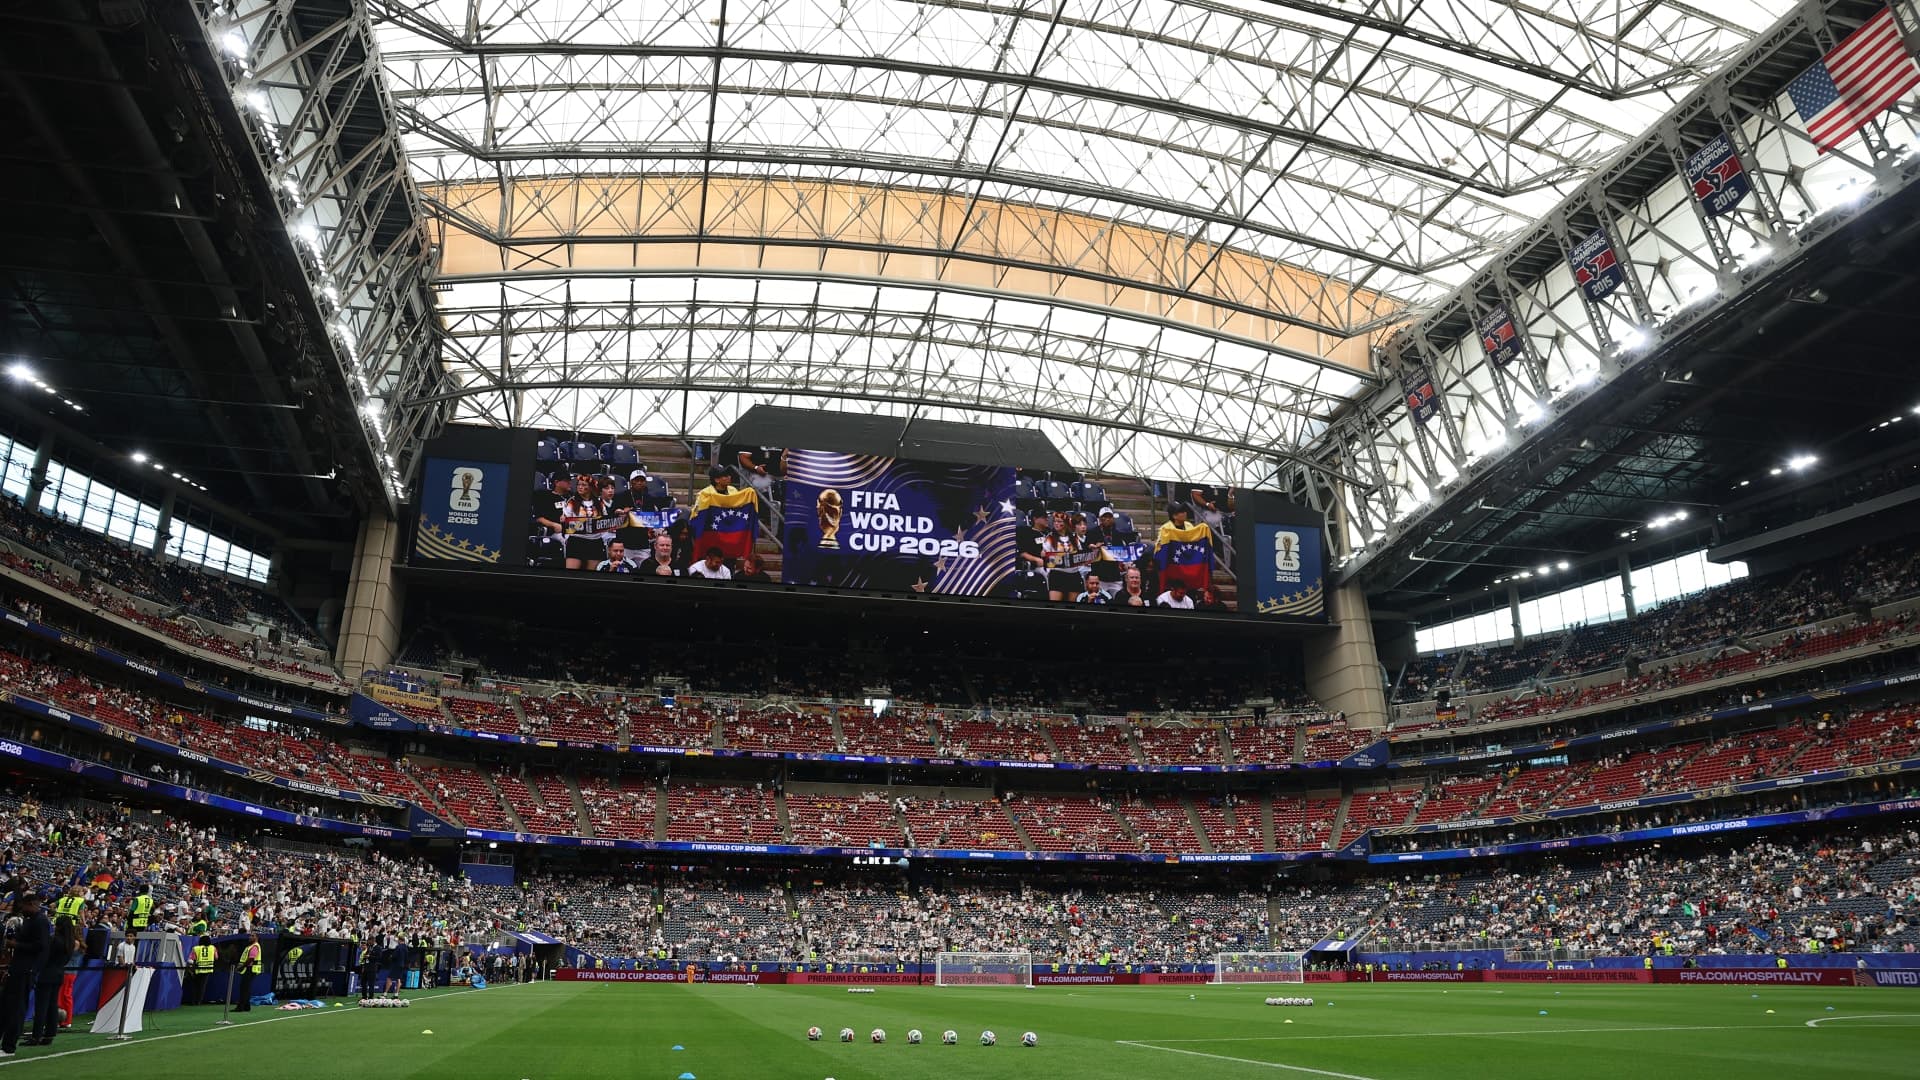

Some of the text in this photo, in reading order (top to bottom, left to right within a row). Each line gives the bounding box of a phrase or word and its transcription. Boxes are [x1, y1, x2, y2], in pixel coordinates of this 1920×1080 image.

[1688, 142, 1729, 177] CHAMPIONS
[1690, 139, 1722, 167] AFC SOUTH
[1712, 186, 1739, 212] 2016
[1571, 237, 1606, 266] CHAMPIONS
[1591, 275, 1614, 297] 2015
[851, 490, 900, 511] FIFA
[447, 516, 478, 525] 2026
[850, 511, 934, 534] WORLD
[849, 532, 980, 559] CUP 2026
[126, 659, 158, 677] HOUSTON
[377, 688, 389, 696] FIFA
[1601, 728, 1638, 741] HOUSTON
[0, 741, 22, 756] 2026
[178, 749, 209, 764] HOUSTON
[122, 774, 149, 789] HOUSTON
[1600, 799, 1640, 811] HOUSTON
[1878, 800, 1920, 812] HOUSTON
[362, 827, 393, 837] HOUSTON
[1672, 820, 1748, 835] FIFA WORLD CUP 2026
[581, 839, 615, 847] HOUSTON
[692, 843, 706, 851] FIFA
[1541, 840, 1570, 849] HOUSTON
[577, 971, 595, 979] FIFA
[594, 972, 627, 980] WORLD
[711, 973, 760, 982] HOSPITALITY
[807, 974, 846, 983] PREMIUM
[847, 974, 900, 984] EXPERIENCES
[1038, 975, 1116, 984] FIFA.COM/HOSPITALITY
[1158, 975, 1194, 983] PREMIUM
[1387, 972, 1465, 981] FIFA.COM/HOSPITALITY
[1680, 971, 1823, 982] FIFA.COM/HOSPITALITY
[1876, 971, 1919, 985] UNITED
